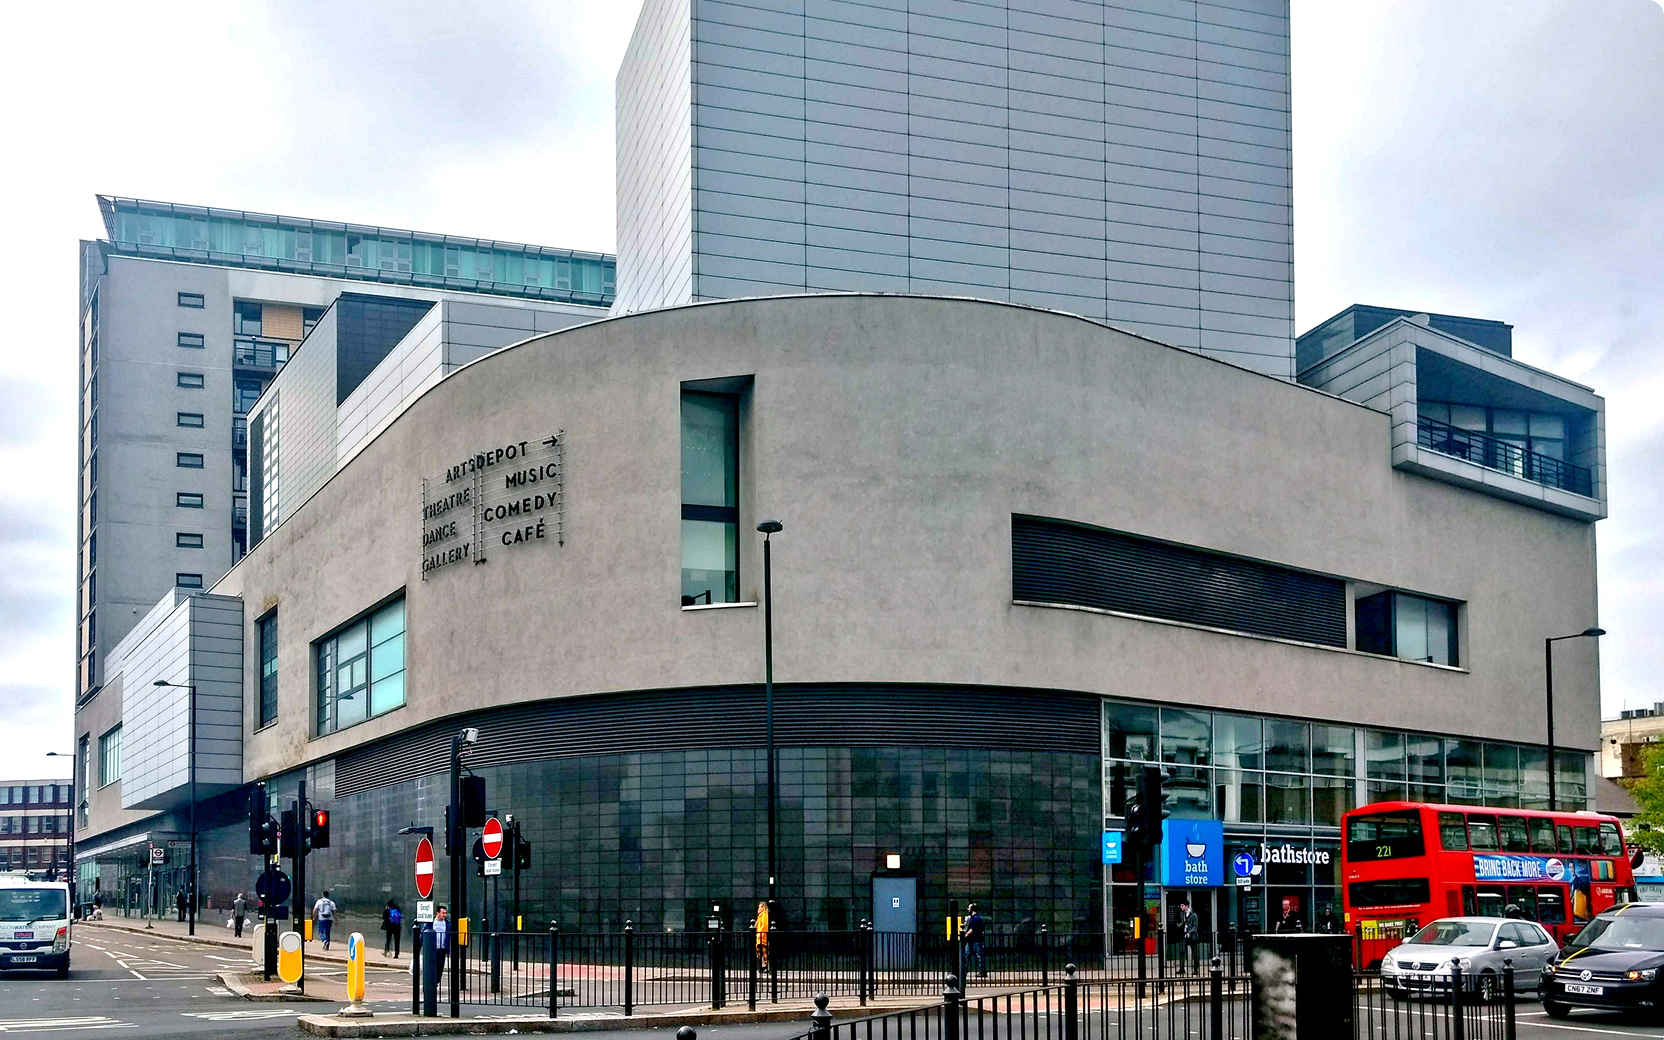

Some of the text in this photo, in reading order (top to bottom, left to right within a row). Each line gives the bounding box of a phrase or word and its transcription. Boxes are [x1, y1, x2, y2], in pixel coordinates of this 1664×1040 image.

[445, 441, 528, 484] ARTSDEPOT
[505, 463, 557, 488] MUSIC
[423, 487, 470, 520] THEATRE
[484, 492, 557, 522] COMEDY
[422, 521, 456, 547] DANCE
[501, 517, 545, 546] CAFÉ
[422, 542, 470, 572] GALLERY
[1260, 843, 1330, 865] bathstore
[1375, 845, 1392, 857] 221
[1184, 860, 1208, 873] bath
[1185, 873, 1208, 885] store
[1479, 859, 1542, 878] BRING BACK MORE
[1567, 984, 1601, 994] CN67 ZNF
